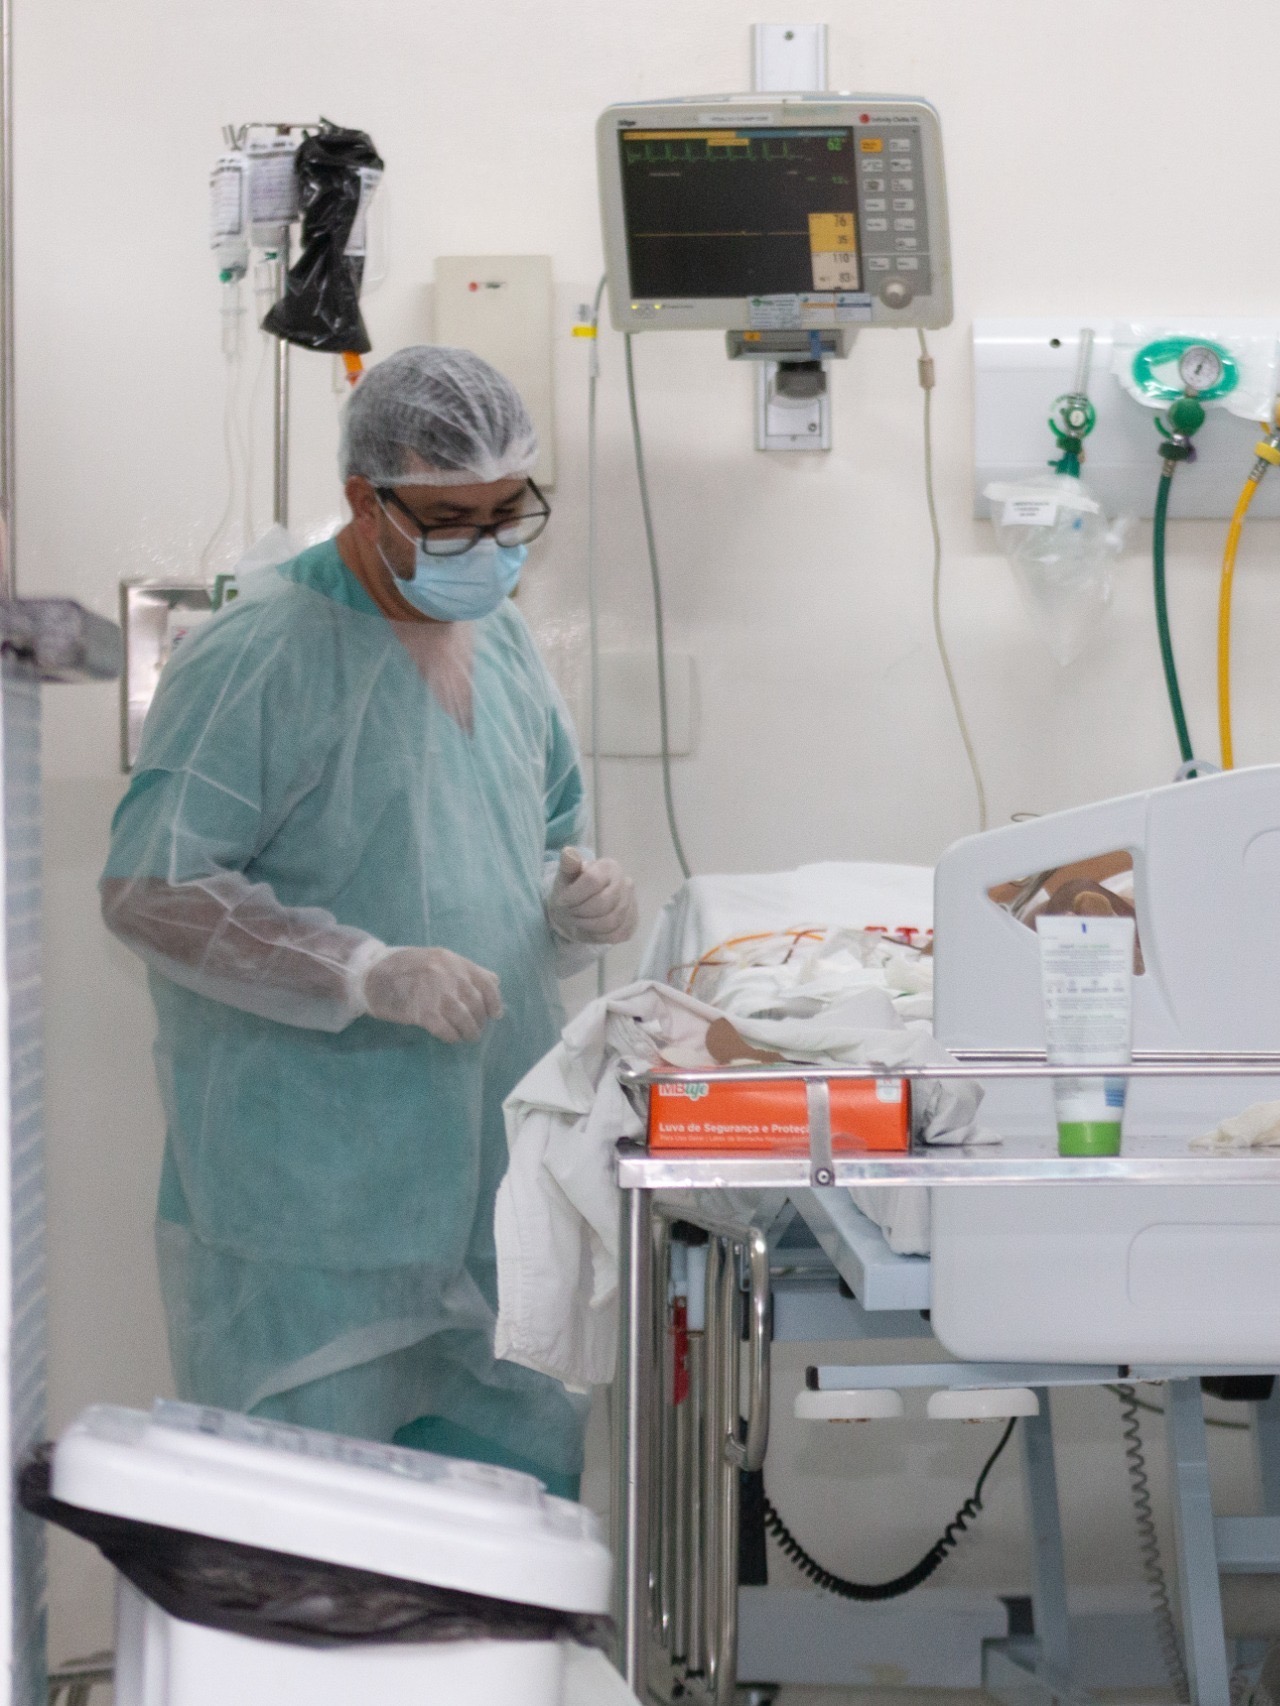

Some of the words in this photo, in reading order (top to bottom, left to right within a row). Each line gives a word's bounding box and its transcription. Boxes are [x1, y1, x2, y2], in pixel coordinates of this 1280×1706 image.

[659, 1122, 684, 1133] Luva
[687, 1122, 701, 1133] de
[703, 1122, 759, 1136] Segurança
[761, 1125, 769, 1134] e
